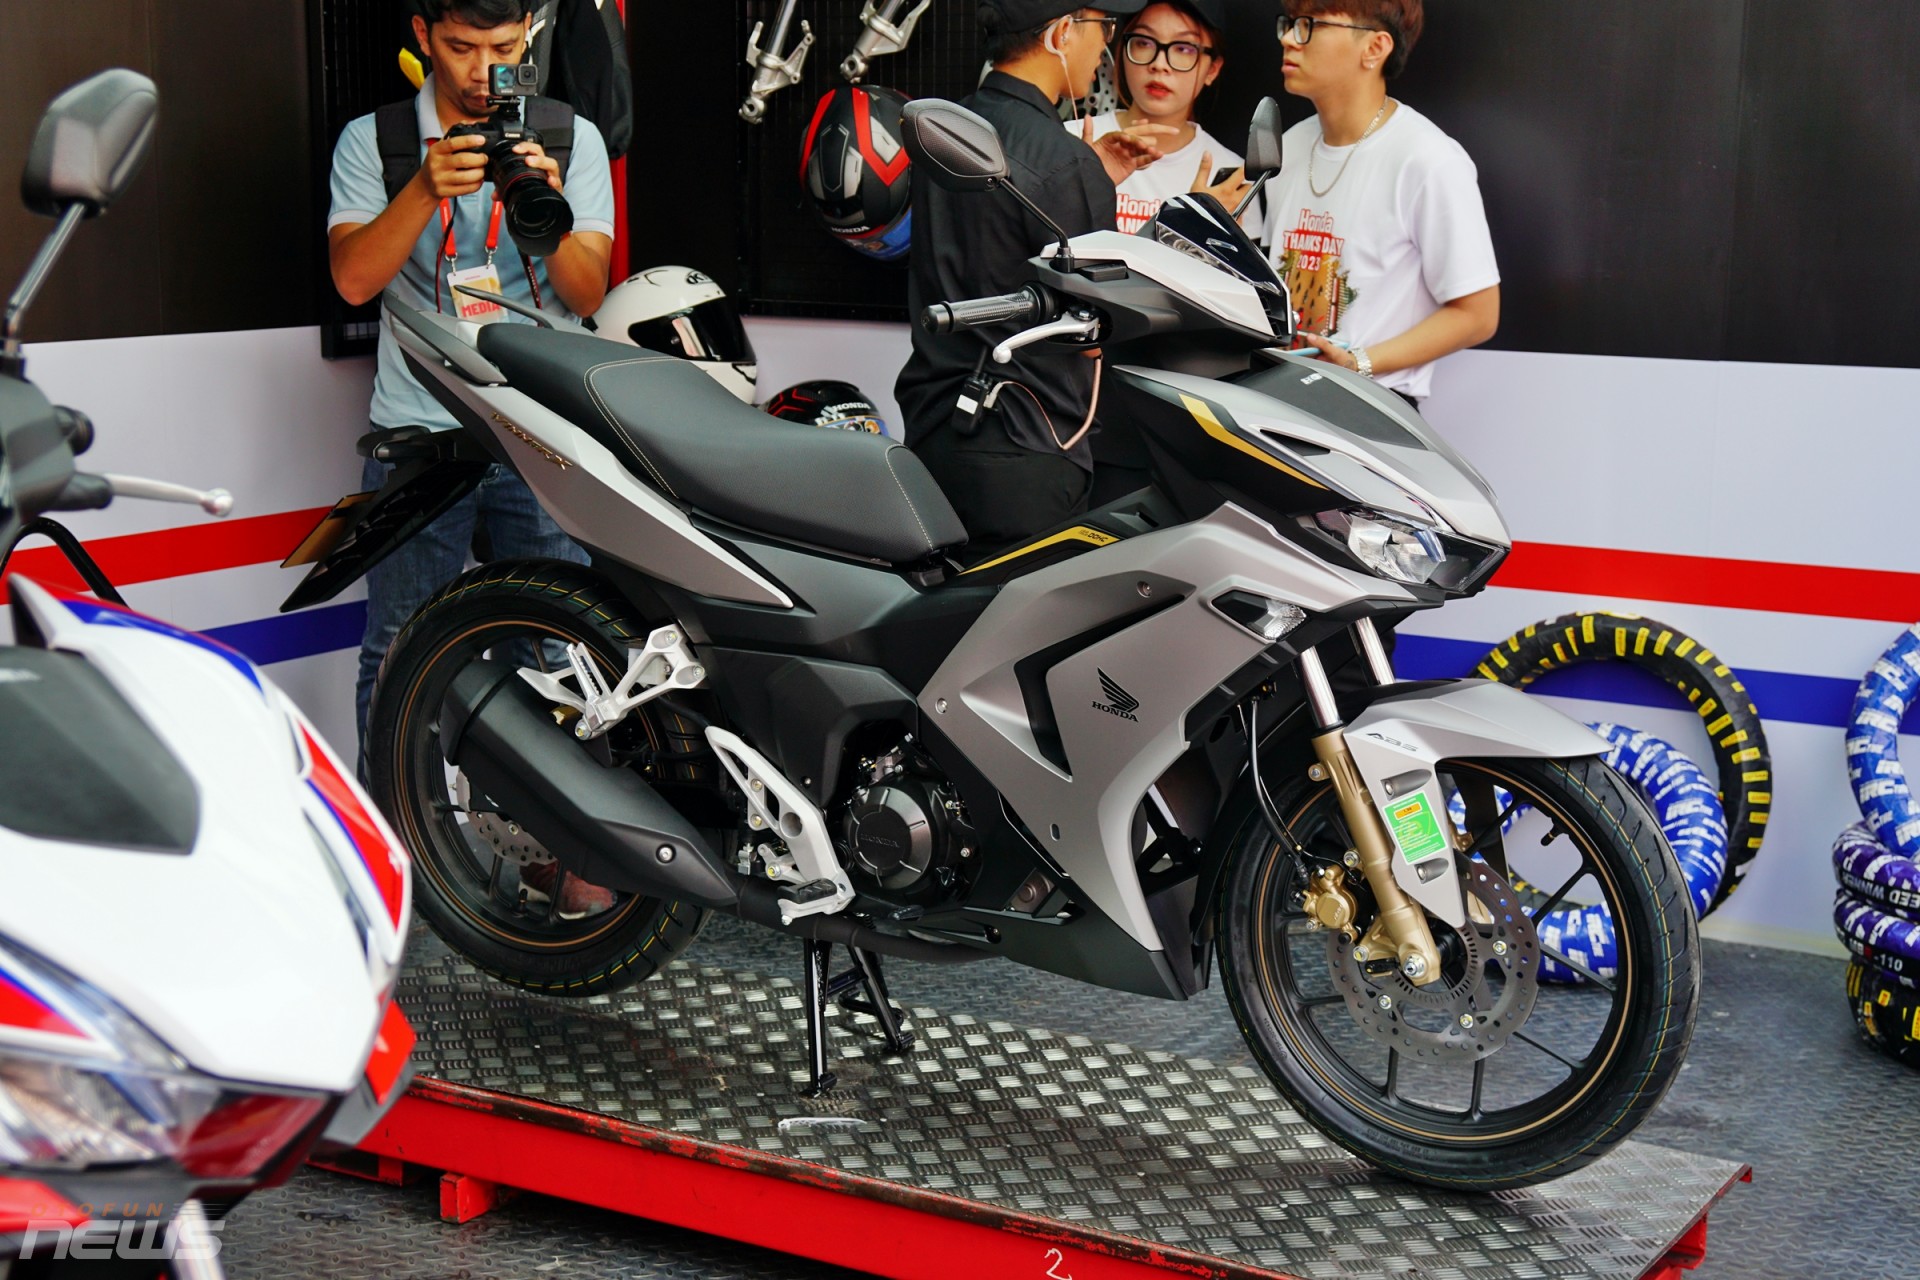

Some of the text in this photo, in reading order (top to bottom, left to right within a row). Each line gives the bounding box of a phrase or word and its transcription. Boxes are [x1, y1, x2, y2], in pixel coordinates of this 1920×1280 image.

[1116, 194, 1160, 217] Hond
[831, 225, 870, 234] HONDA
[1299, 208, 1334, 233] Honda
[1321, 236, 1344, 256] DAY
[461, 301, 502, 318] MEDIA
[832, 402, 871, 412] HONDA
[1092, 701, 1139, 723] HONDA
[1366, 733, 1419, 752] ABS
[1044, 1248, 1073, 1280] 2
